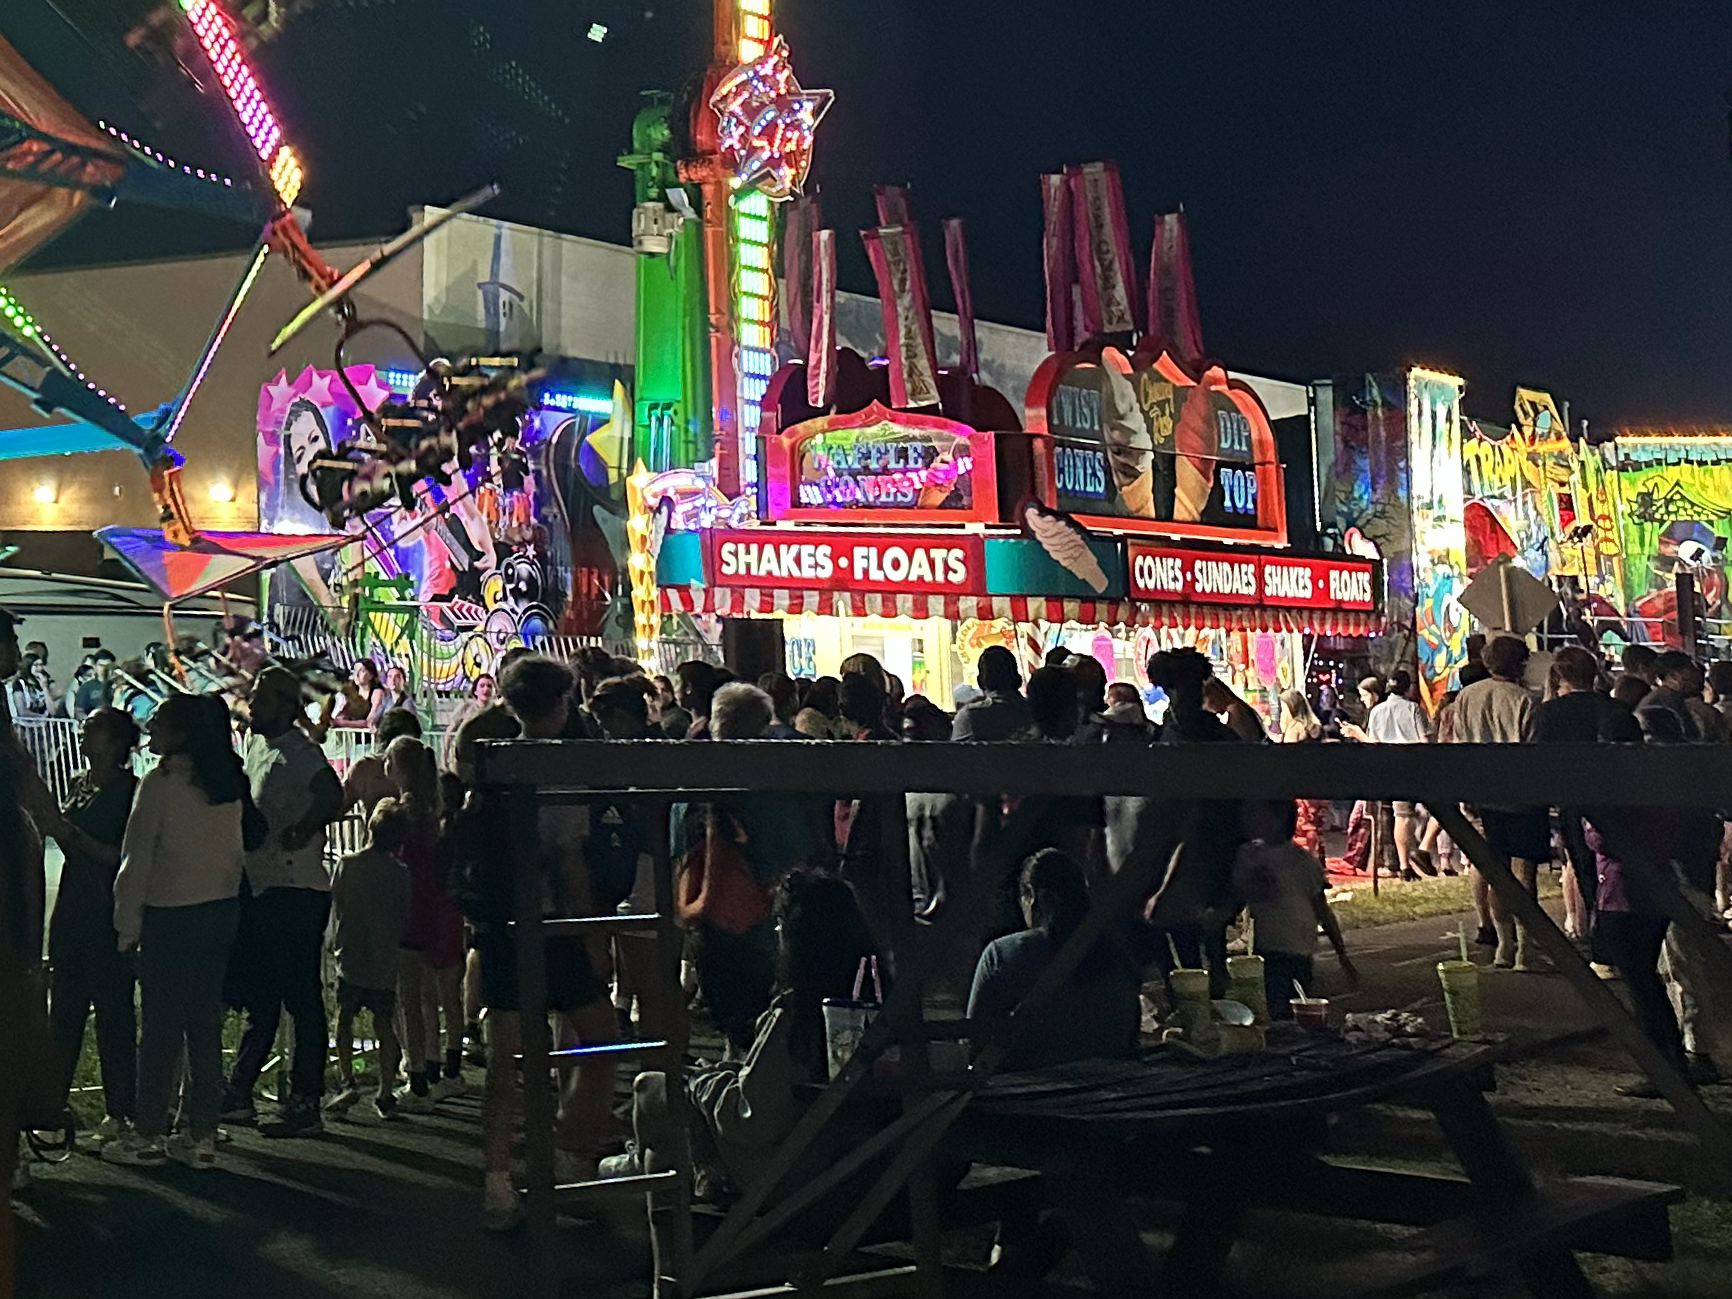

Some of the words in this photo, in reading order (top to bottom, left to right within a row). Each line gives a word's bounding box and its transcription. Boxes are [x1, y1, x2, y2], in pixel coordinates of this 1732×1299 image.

[1051, 384, 1101, 431] TWIST
[1218, 410, 1251, 452] DIP
[809, 442, 924, 471] WAFFLE
[1054, 447, 1106, 498] CONES
[817, 474, 916, 504] CONES
[1220, 468, 1258, 514] TOP
[720, 542, 834, 579] SHAKES
[853, 546, 967, 584] FLOATS
[1134, 555, 1184, 591] CONES
[1194, 560, 1257, 596] SUNDAES
[1264, 564, 1313, 599] SHAKES
[1329, 569, 1372, 602] FLOATS
